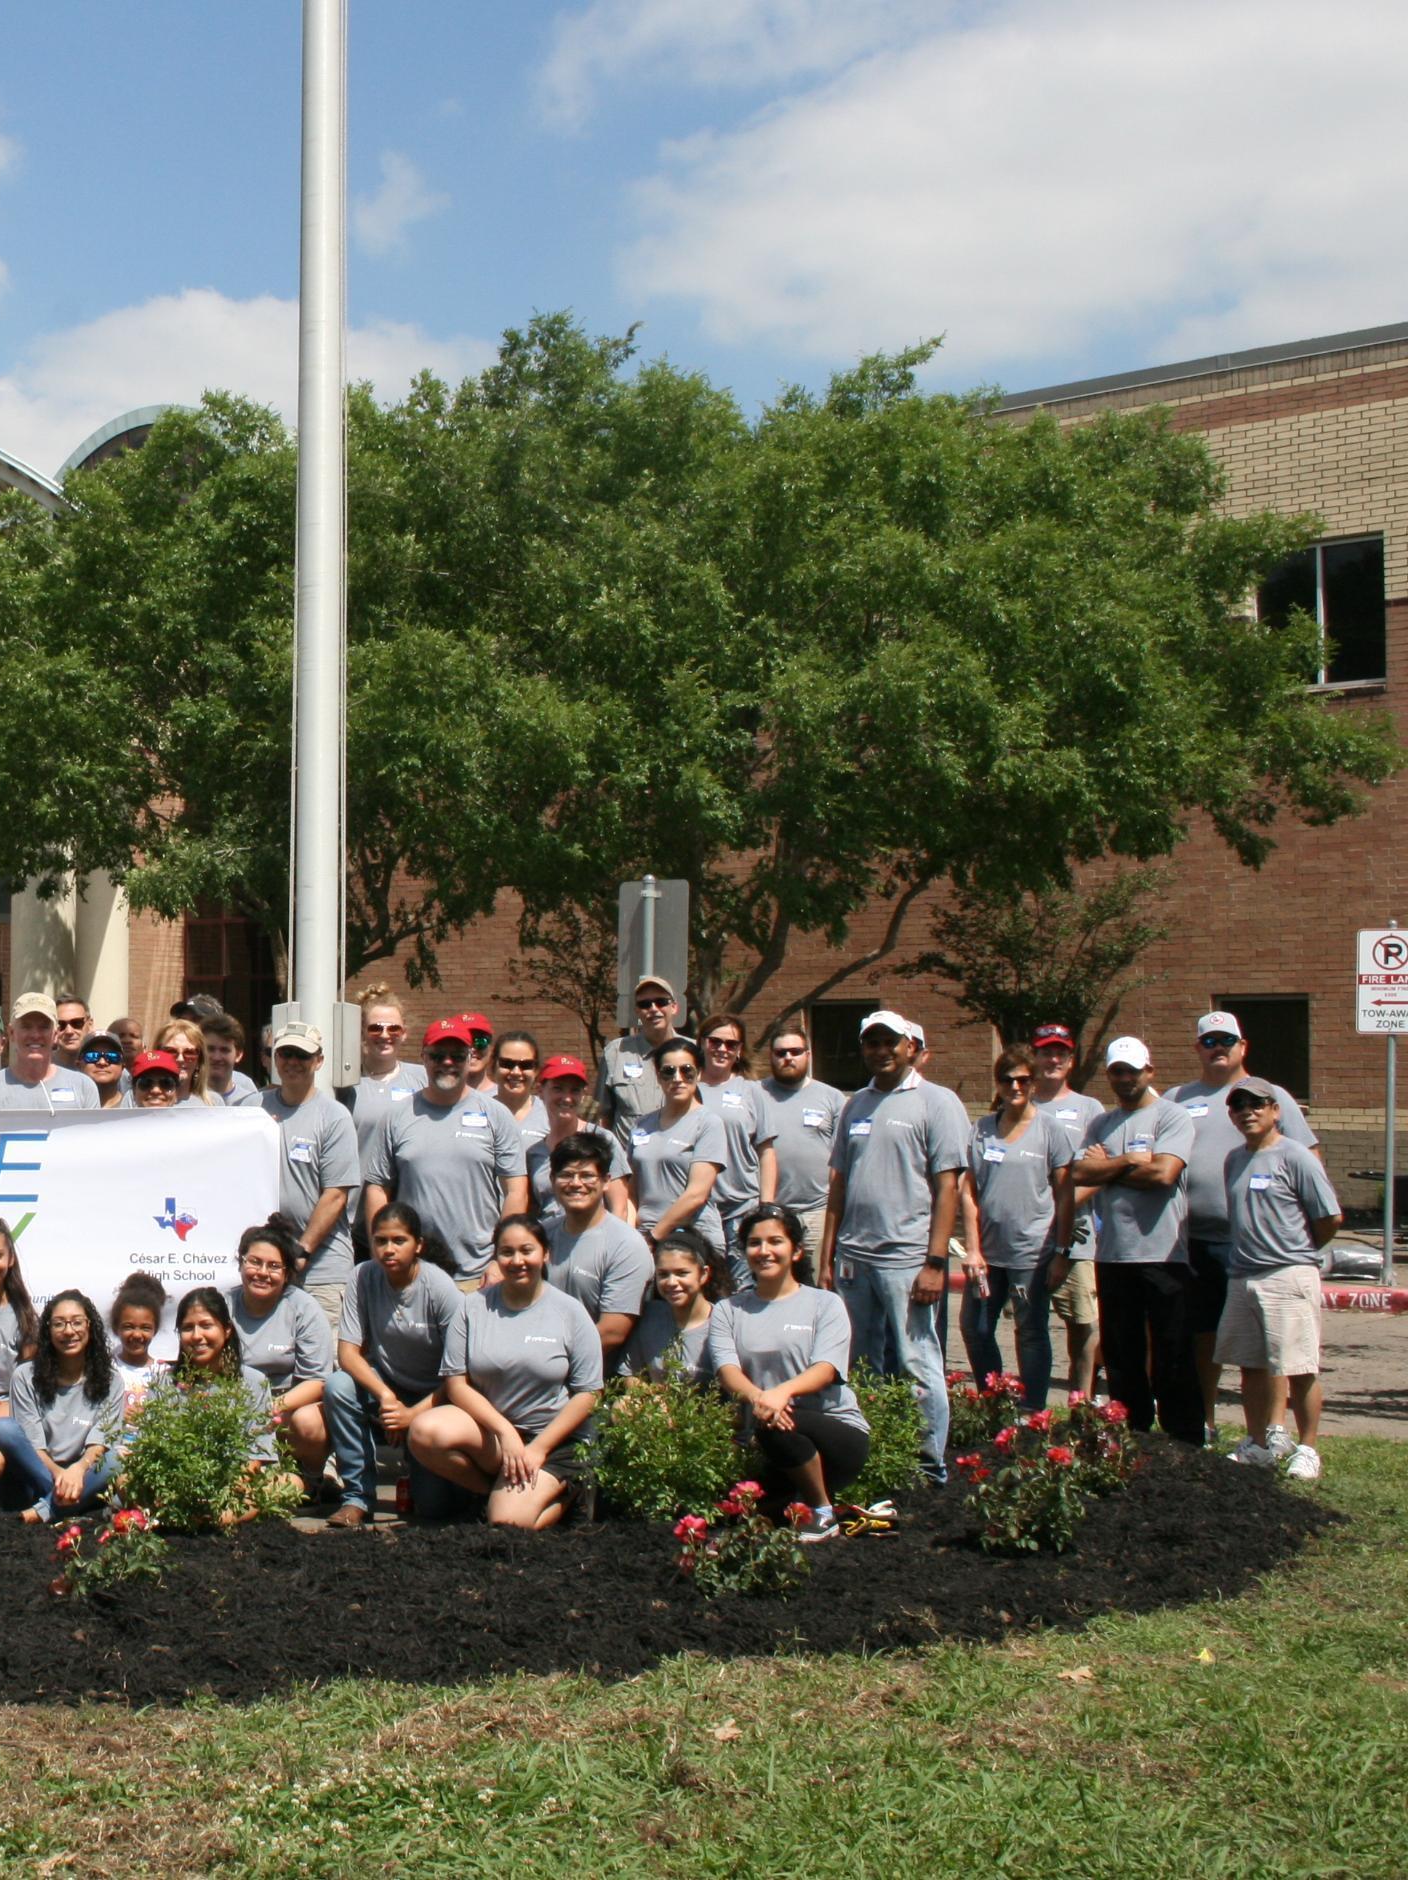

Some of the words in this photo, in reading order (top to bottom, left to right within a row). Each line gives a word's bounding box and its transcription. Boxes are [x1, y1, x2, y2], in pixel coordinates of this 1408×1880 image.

[1361, 975, 1387, 984] FIRE
[1361, 1009, 1408, 1018] TOW-AW
[1375, 1020, 1406, 1028] ZONE
[129, 1252, 164, 1264] César
[168, 1252, 179, 1264] E.
[183, 1252, 228, 1264] Chávez
[173, 1269, 216, 1281] School
[1348, 1292, 1392, 1310] ZONE
